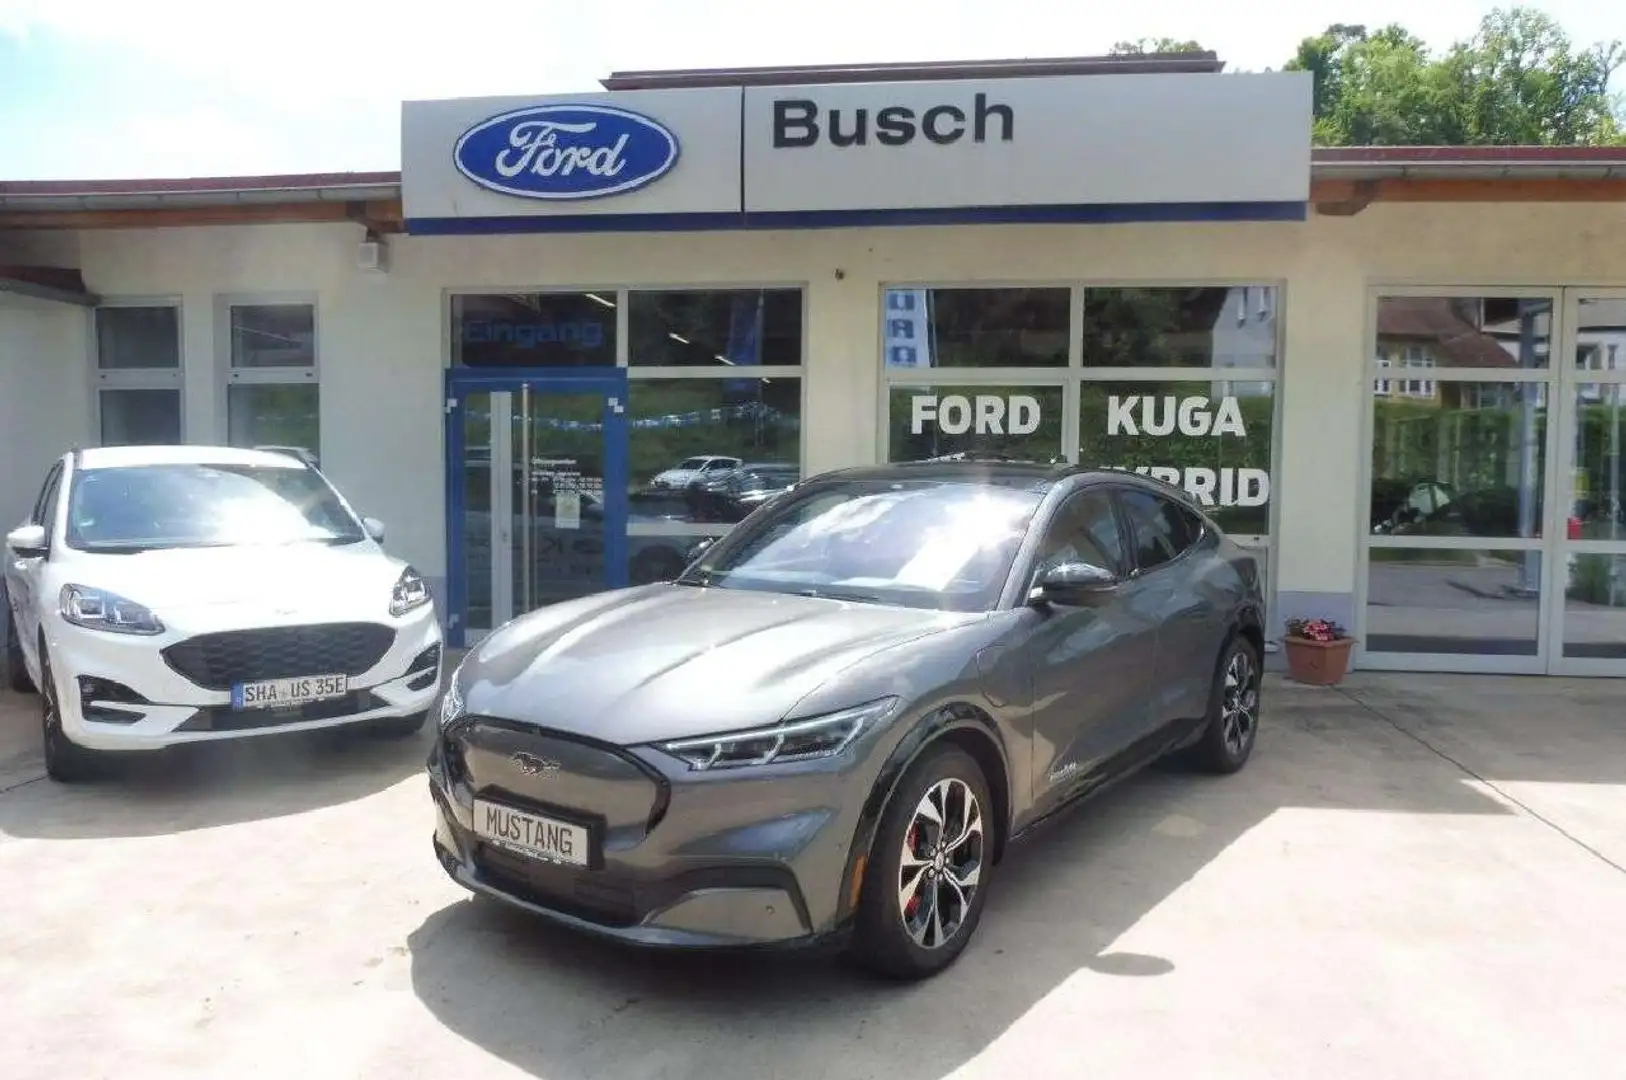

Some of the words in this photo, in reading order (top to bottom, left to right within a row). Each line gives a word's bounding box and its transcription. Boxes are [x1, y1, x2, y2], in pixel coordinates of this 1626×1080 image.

[773, 93, 1014, 149] Busch
[495, 121, 630, 177] Ford
[911, 395, 1041, 436] FORD
[1107, 395, 1246, 437] KUGA
[1098, 466, 1270, 507] RID
[245, 684, 277, 702] SHA
[291, 680, 310, 697] US
[315, 676, 345, 695] 35E
[486, 806, 572, 857] MUSTANG
